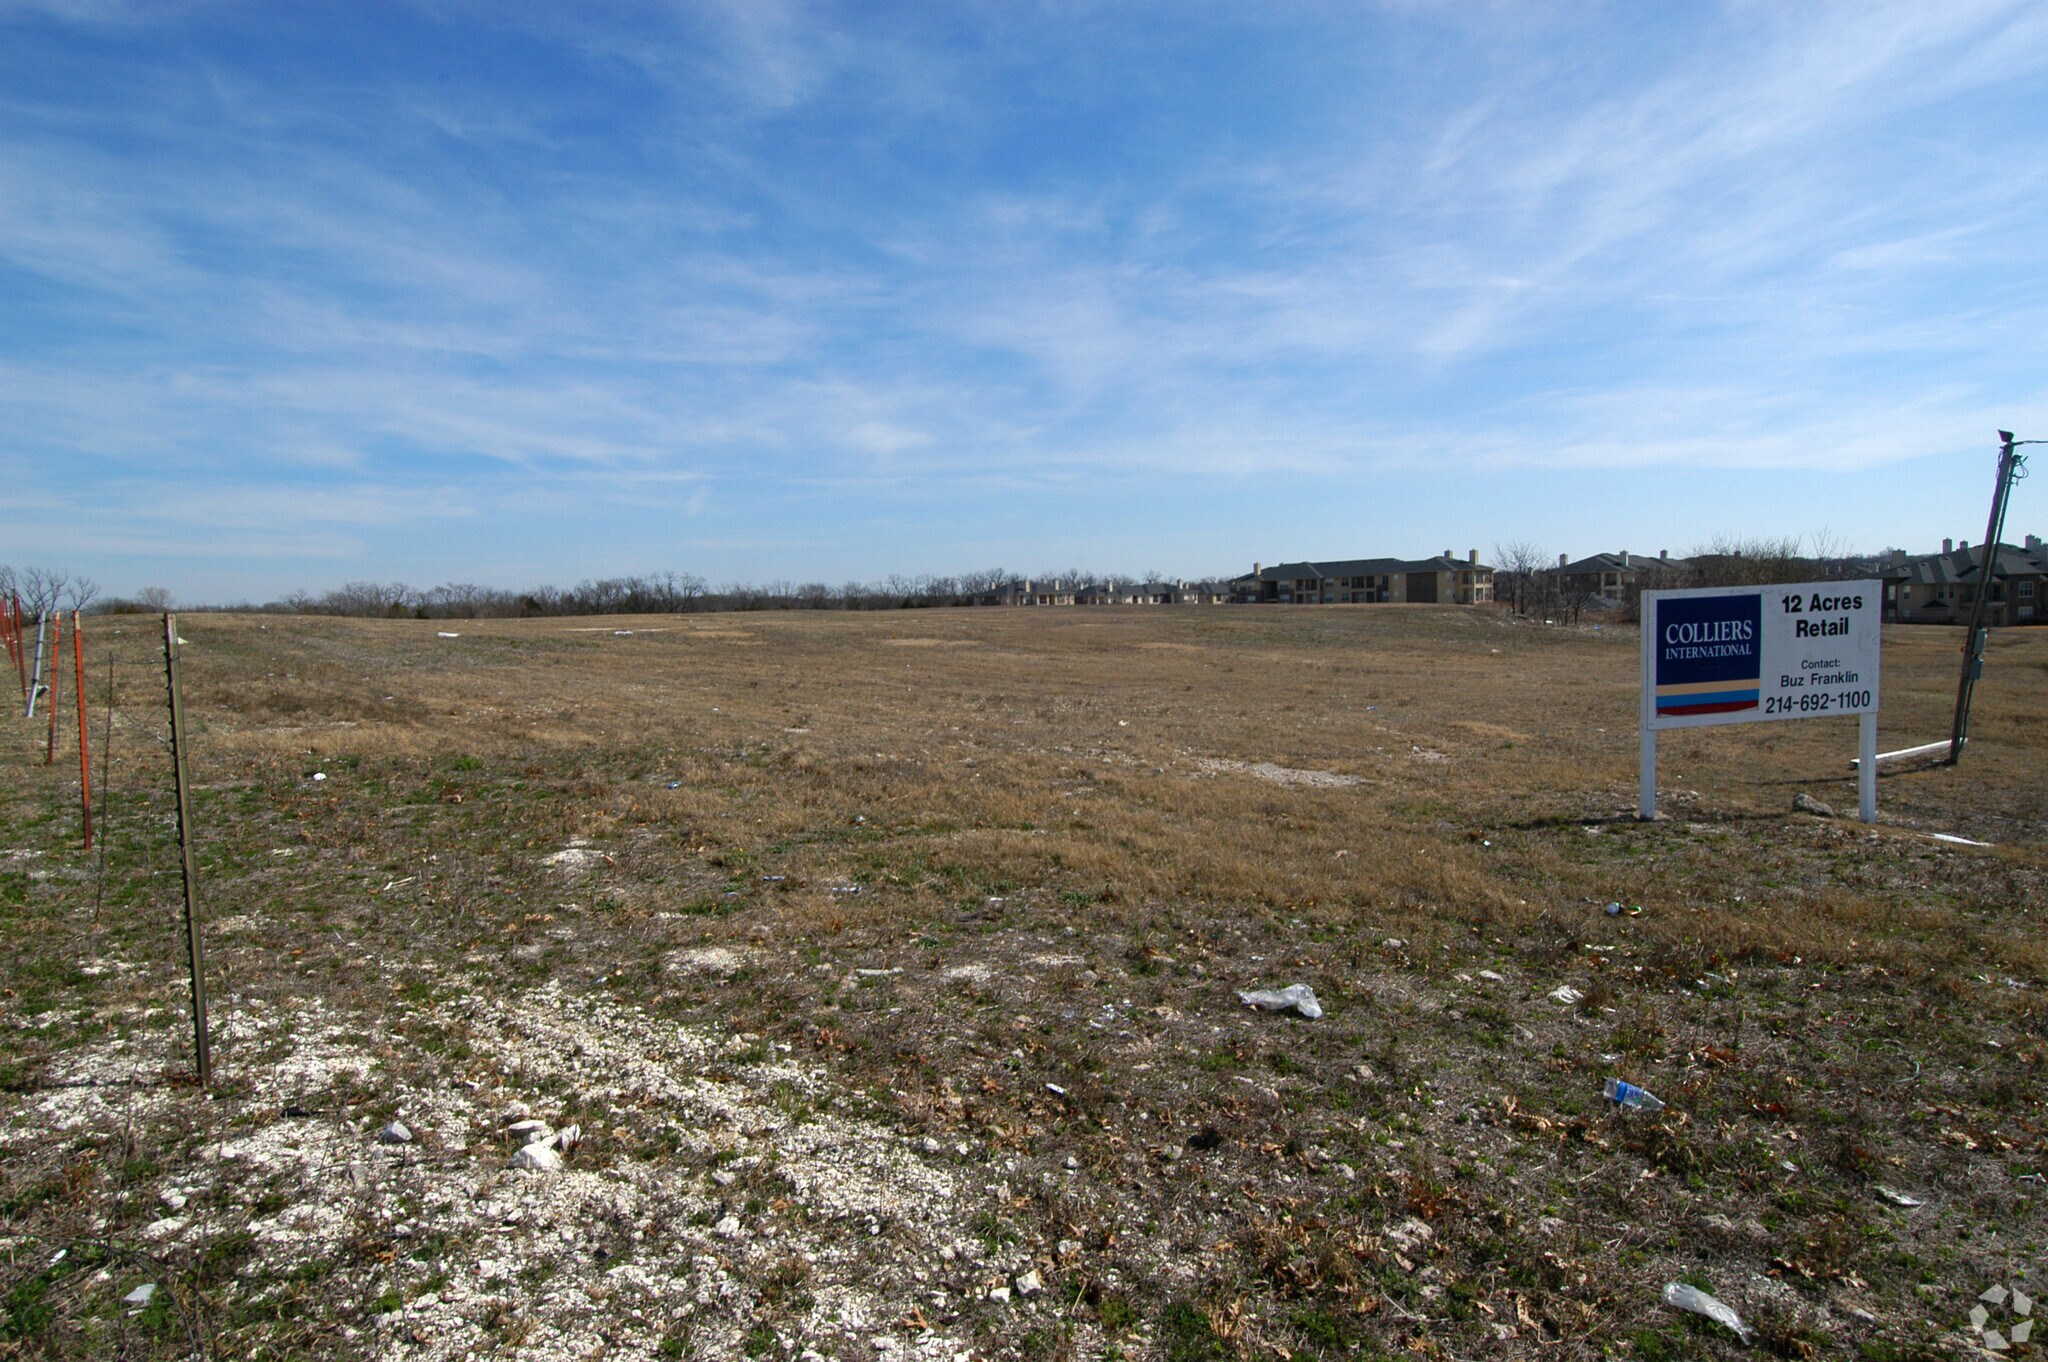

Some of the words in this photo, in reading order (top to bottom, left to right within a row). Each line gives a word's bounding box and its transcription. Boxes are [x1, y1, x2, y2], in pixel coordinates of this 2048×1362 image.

[1782, 594, 1802, 613] 12
[1809, 593, 1863, 612] Acres
[1665, 619, 1752, 644] COLLIERS
[1796, 617, 1849, 638] Retail
[1665, 644, 1752, 660] INTERNATIONAL
[1801, 658, 1841, 670] Contact:
[1780, 674, 1804, 688] Buz
[1810, 671, 1859, 686] Franklin
[1765, 690, 1871, 714] 214-692-1100
